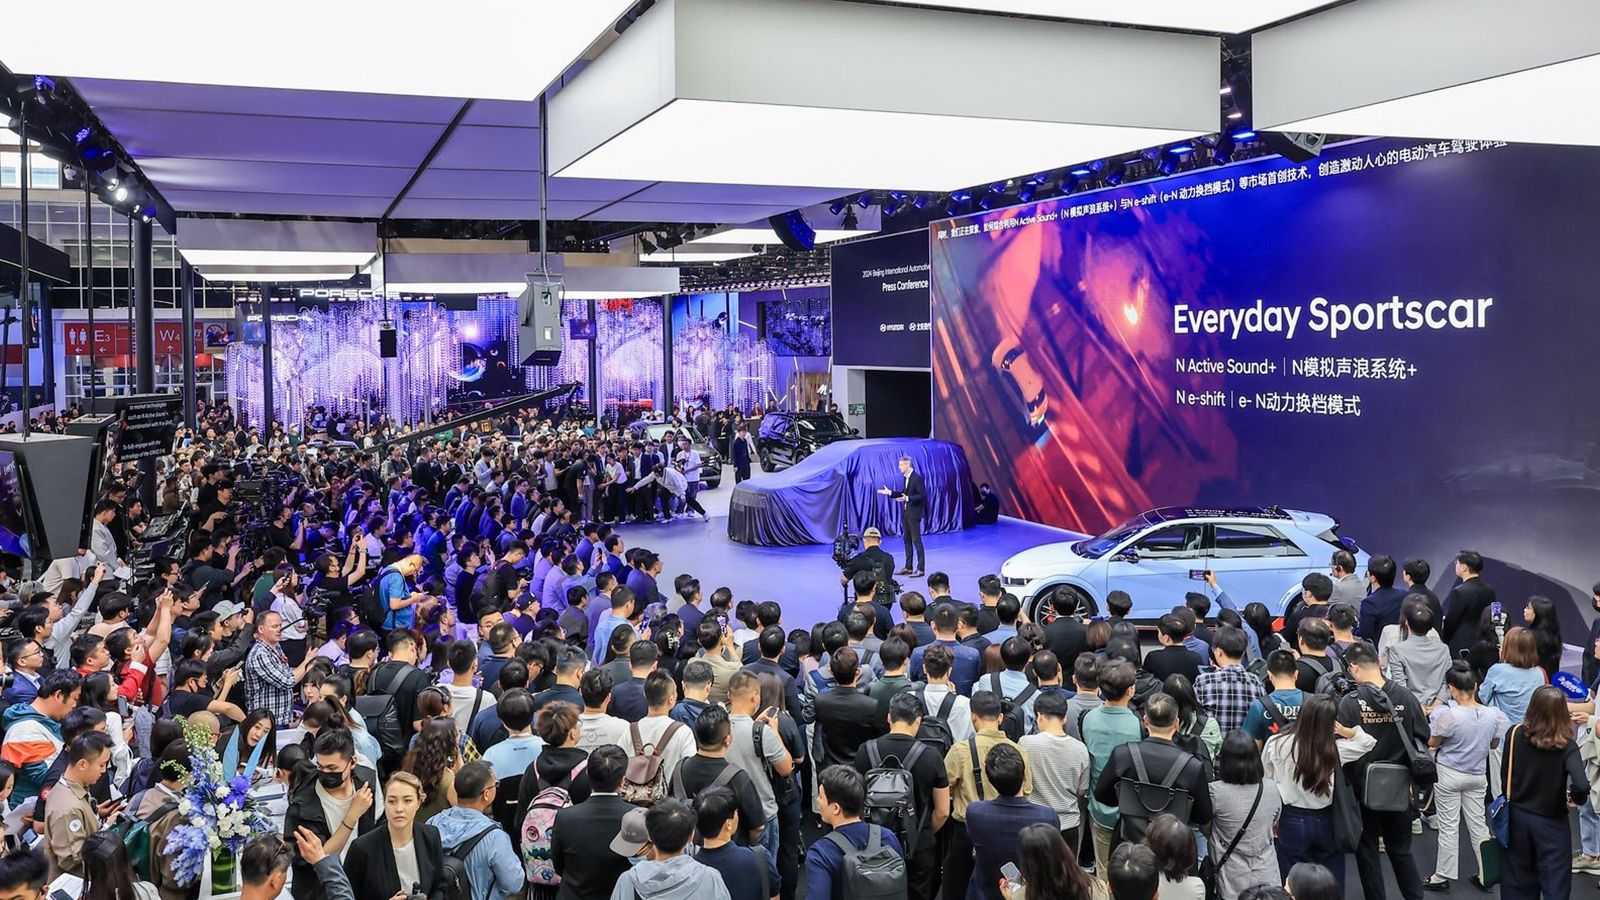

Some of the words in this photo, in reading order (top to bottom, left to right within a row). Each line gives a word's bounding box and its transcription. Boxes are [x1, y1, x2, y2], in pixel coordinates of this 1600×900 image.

[885, 264, 909, 276] International
[882, 282, 897, 292] Press
[897, 279, 929, 291] Conference
[1173, 299, 1302, 340] Everyday
[1308, 295, 1493, 339] Sportscar
[1176, 358, 1185, 373] N
[1187, 358, 1225, 374] Active
[1227, 358, 1277, 375] Sound+
[1292, 357, 1418, 380] N模拟声浪系统+
[1176, 390, 1185, 404] N
[1188, 390, 1226, 407] e-shift
